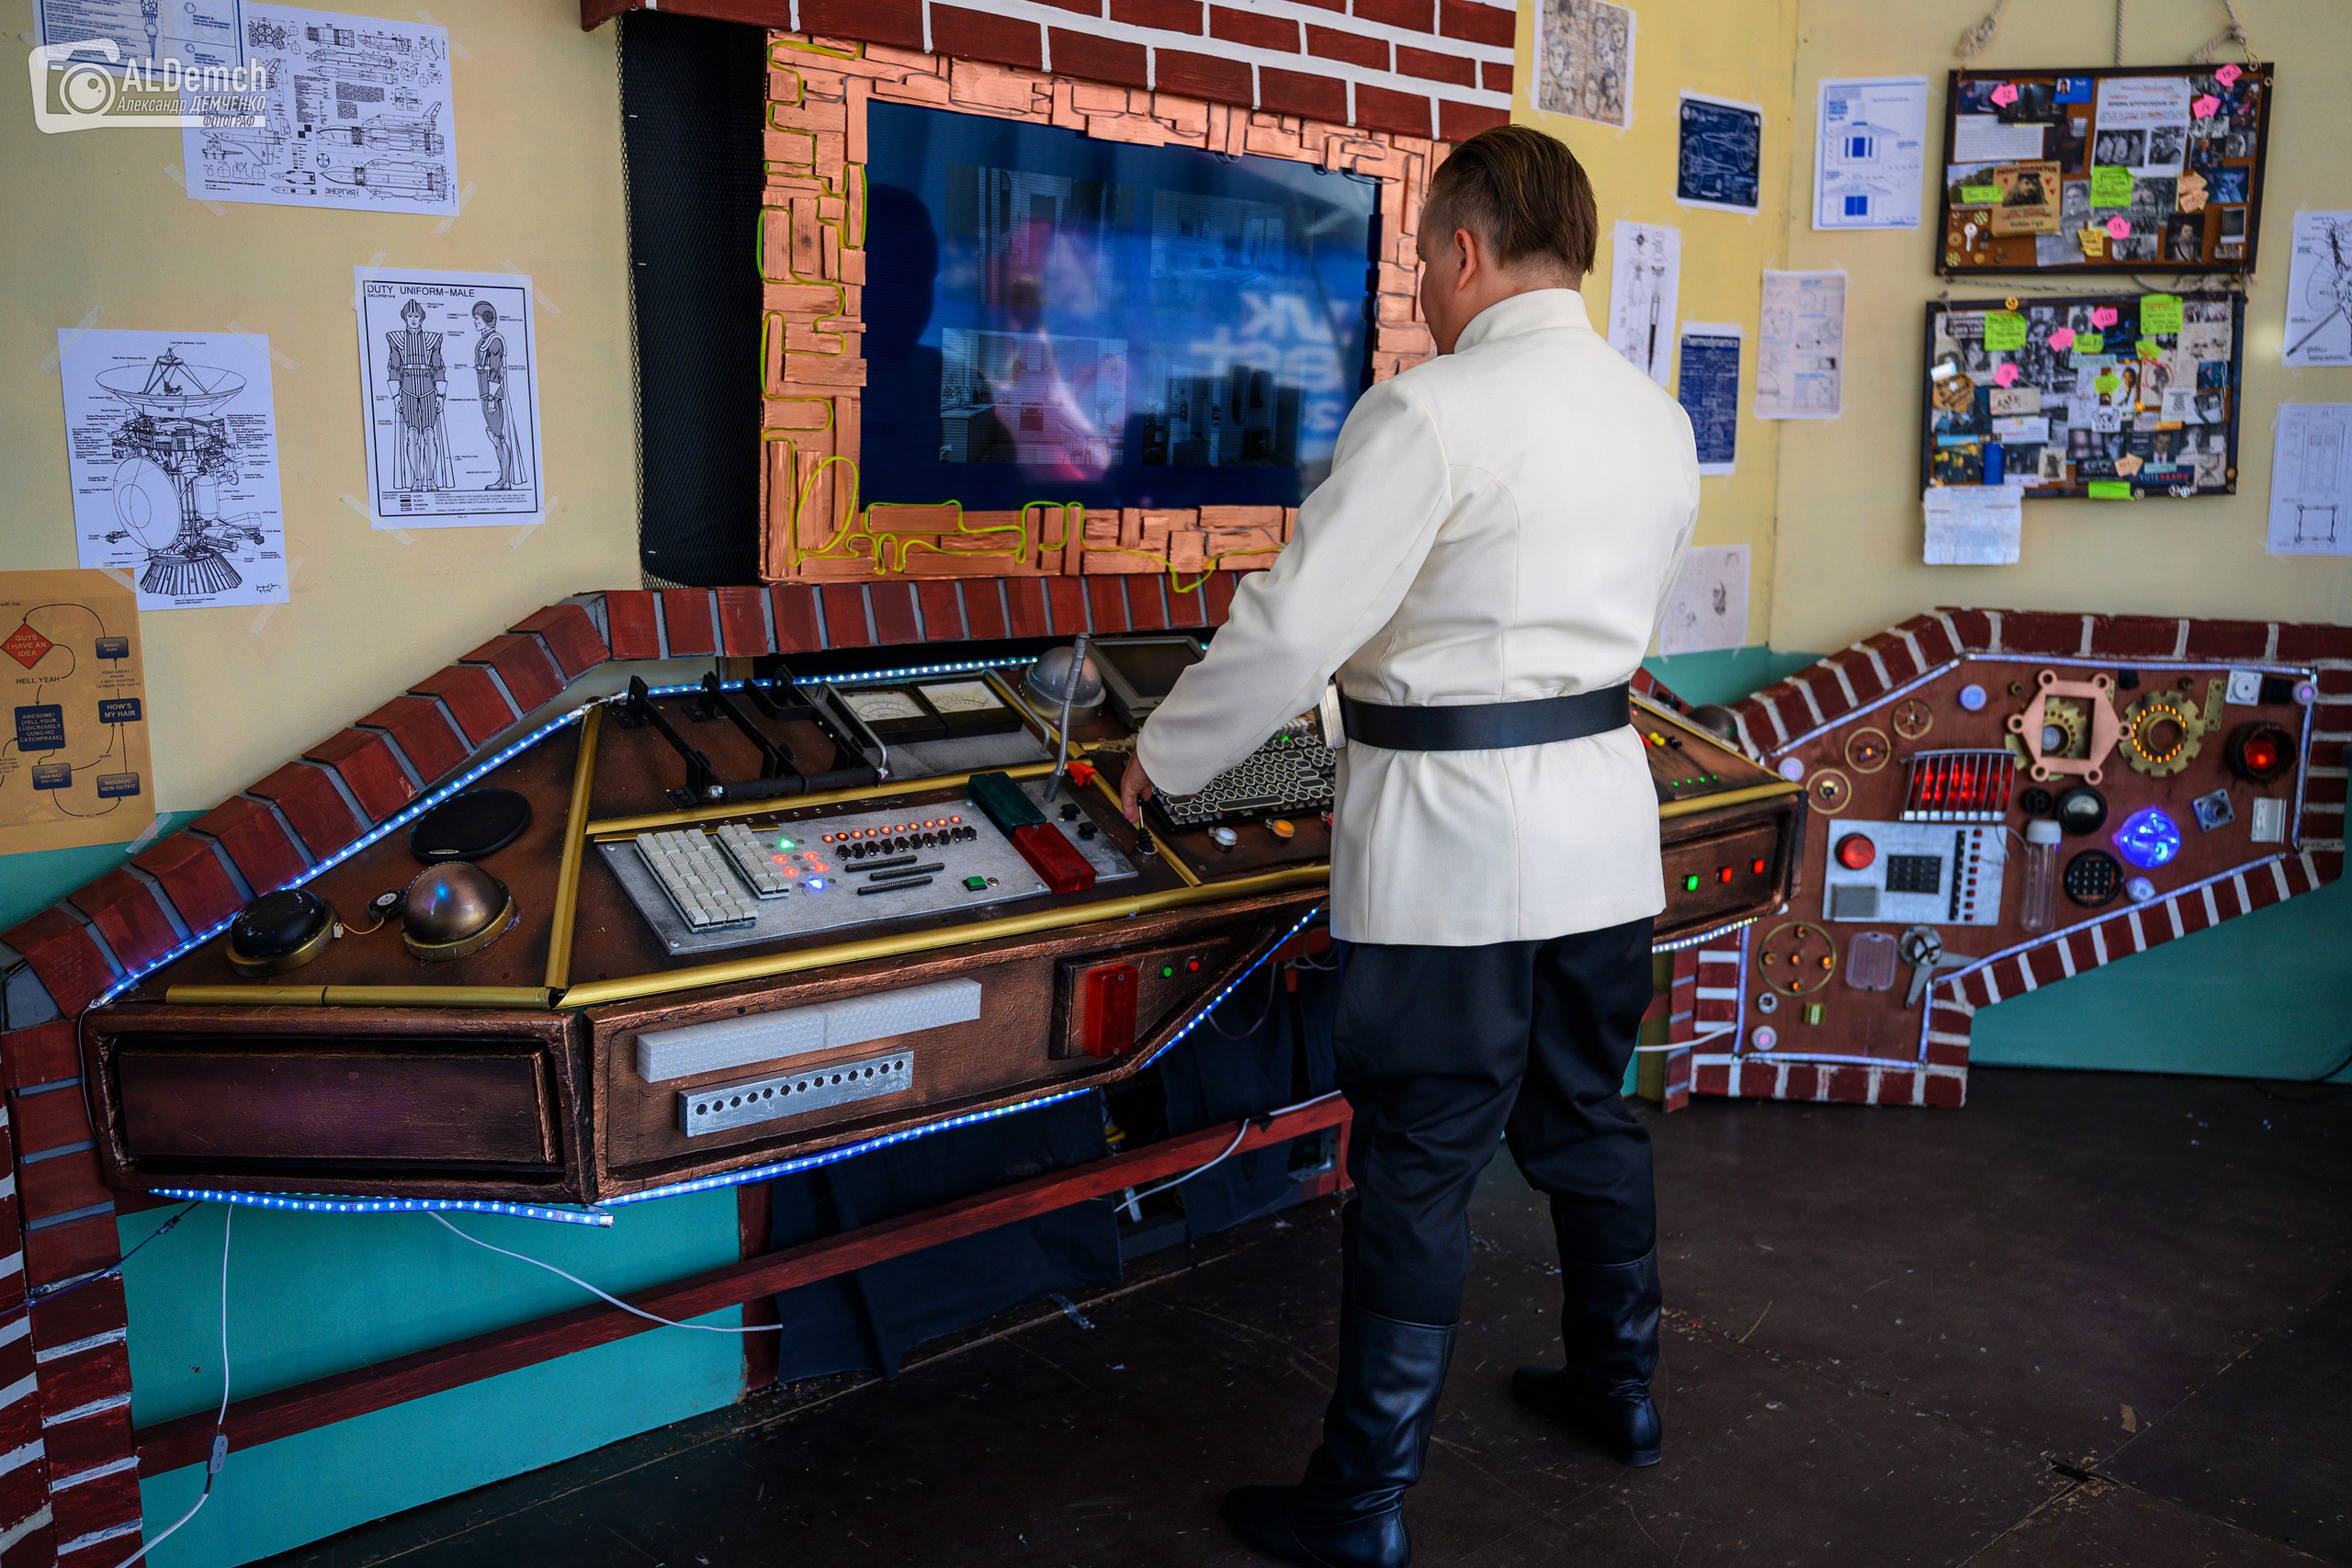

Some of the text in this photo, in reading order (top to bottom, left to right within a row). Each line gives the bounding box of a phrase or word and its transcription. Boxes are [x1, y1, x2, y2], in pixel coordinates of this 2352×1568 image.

[324, 187, 356, 197] ЭНЕРГИЯ
[368, 284, 475, 298] DUTY UNIFORM-MALE
[15, 634, 38, 642] GUYS
[17, 649, 38, 658] IDEA
[38, 675, 61, 683] YEAH
[22, 712, 55, 720] AWESOME!
[18, 723, 62, 731] LUDICROUSLY
[104, 778, 131, 786] WOOHOO
